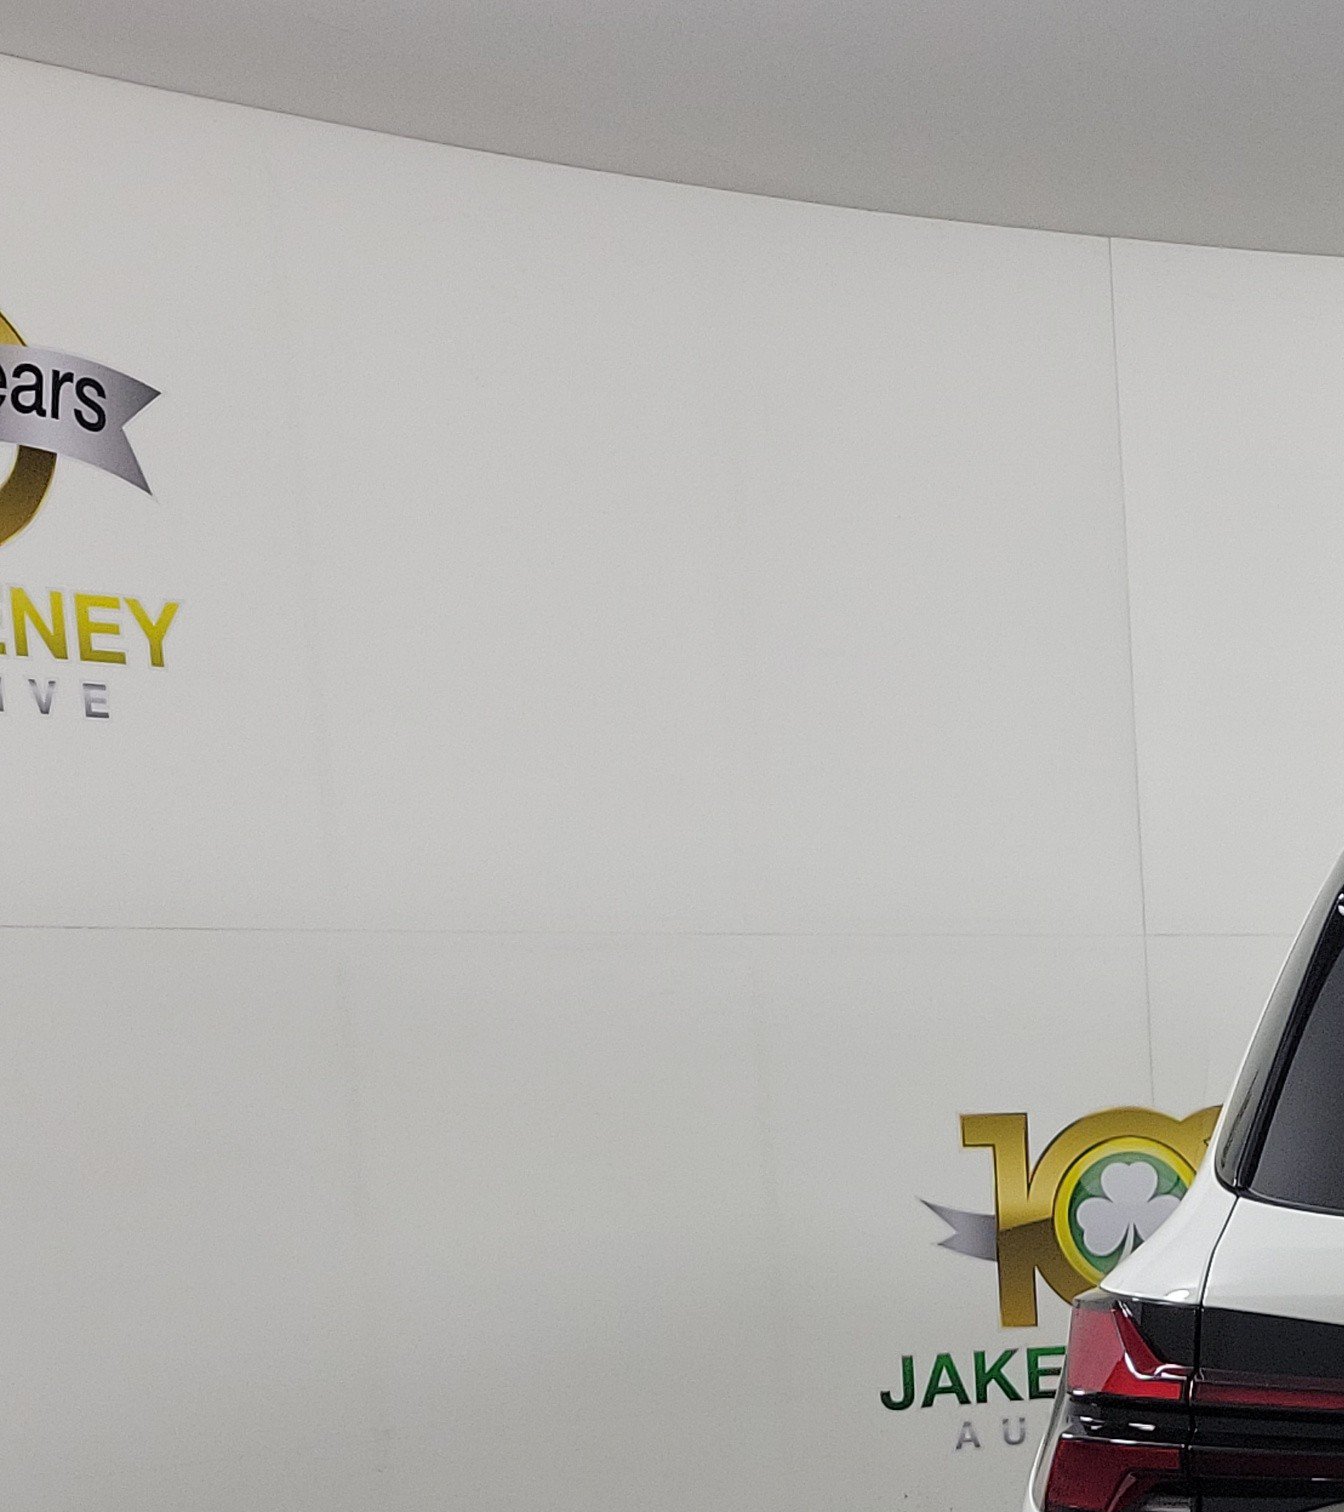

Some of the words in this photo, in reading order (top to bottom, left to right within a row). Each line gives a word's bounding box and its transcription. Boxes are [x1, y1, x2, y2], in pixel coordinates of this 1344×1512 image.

[0, 363, 107, 432] ars
[0, 587, 179, 667] NEY
[880, 1346, 1067, 1411] JAKE
